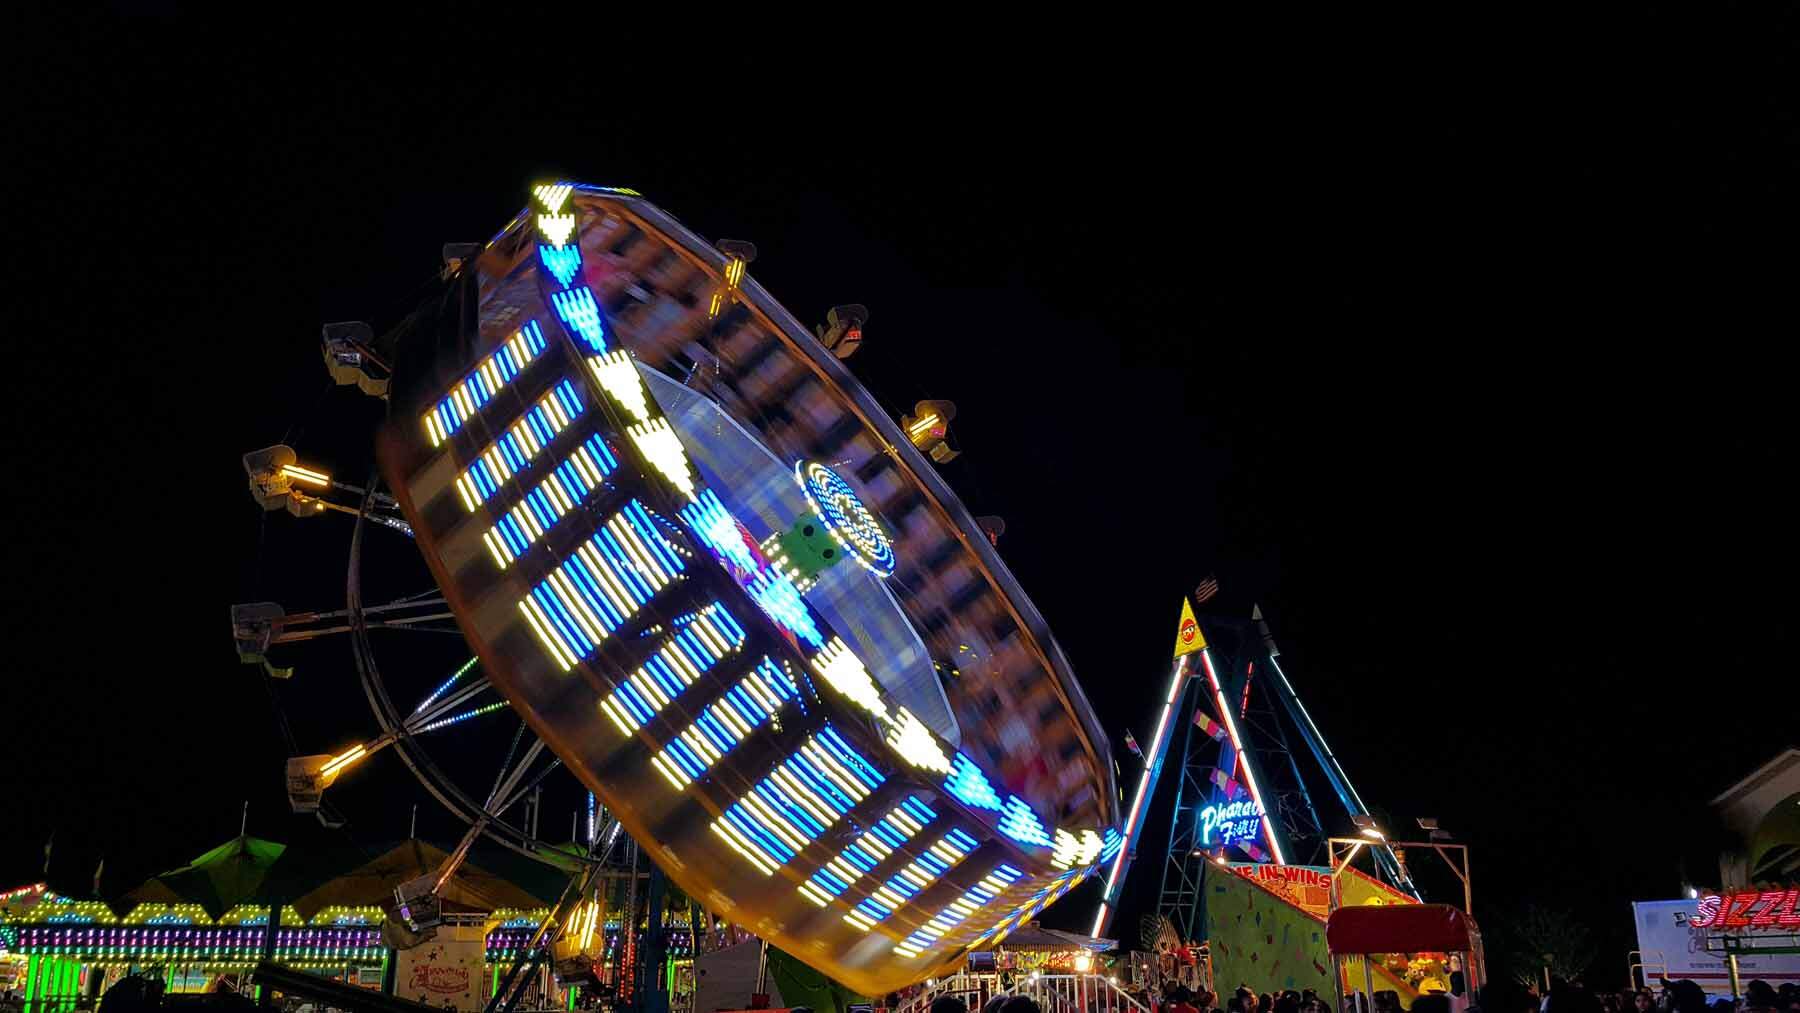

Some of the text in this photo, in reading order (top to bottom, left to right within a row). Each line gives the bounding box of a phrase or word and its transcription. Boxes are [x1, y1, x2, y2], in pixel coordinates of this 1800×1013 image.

[1200, 800, 1263, 846] Pharao
[1258, 865, 1279, 881] IN
[1283, 867, 1332, 889] WINS
